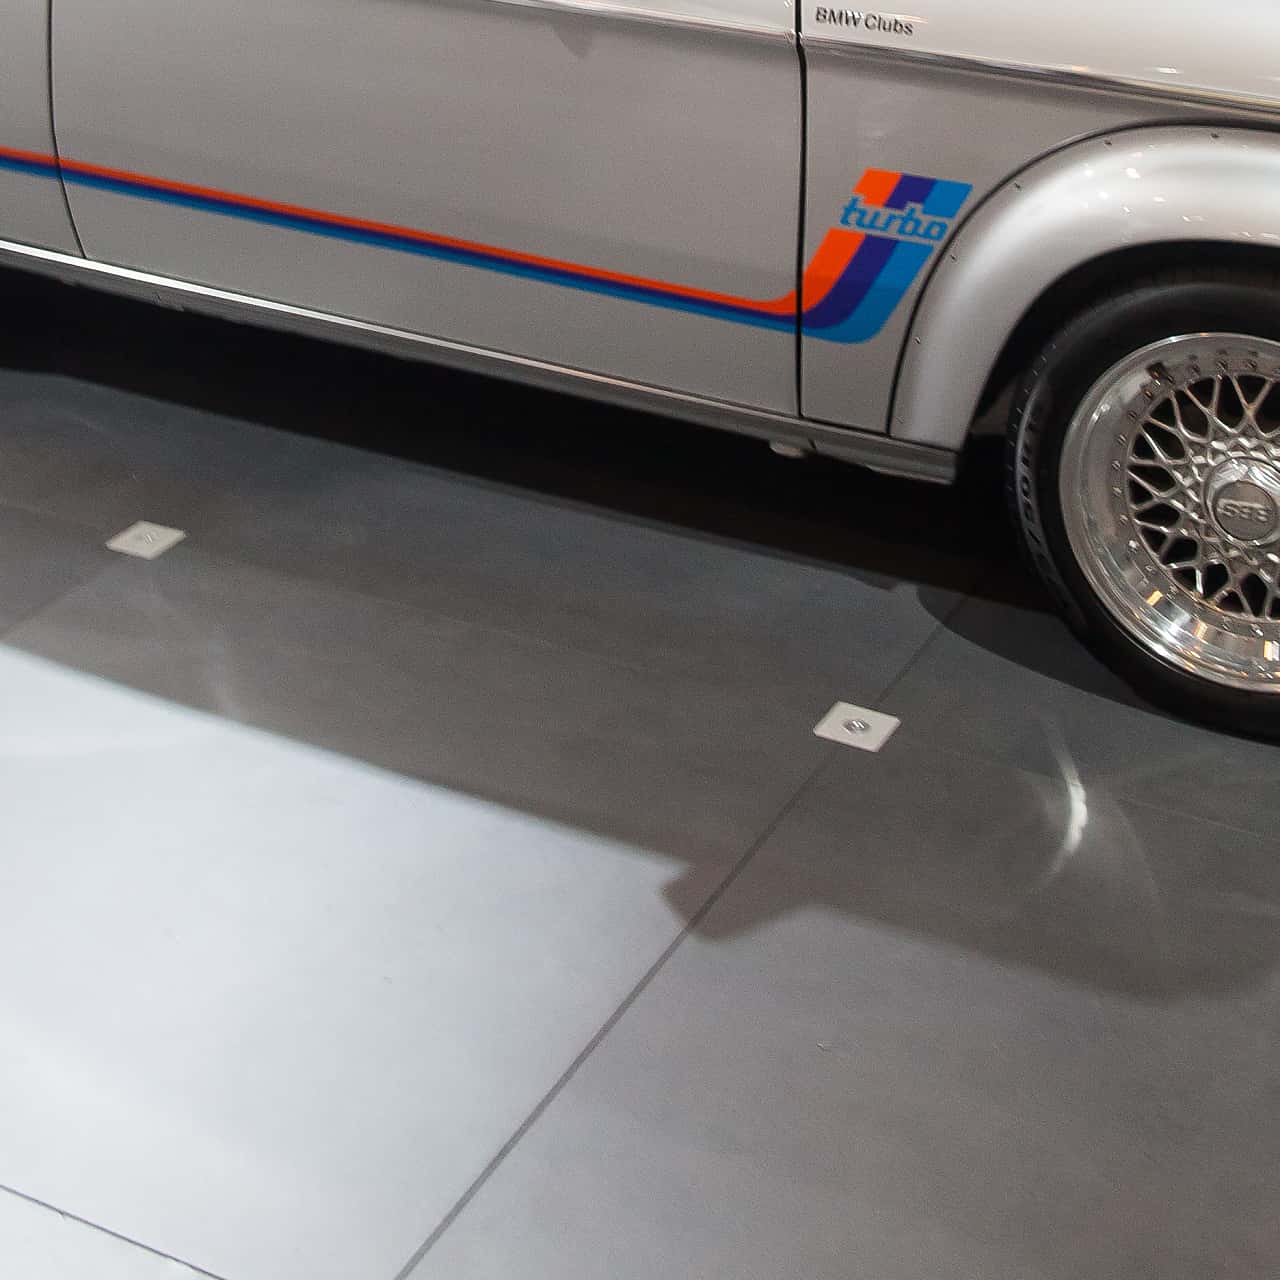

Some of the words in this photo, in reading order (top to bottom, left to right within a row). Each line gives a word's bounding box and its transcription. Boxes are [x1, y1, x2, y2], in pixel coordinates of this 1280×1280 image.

[815, 5, 863, 28] BMW
[864, 12, 915, 36] Clubs
[839, 195, 949, 243] turbo
